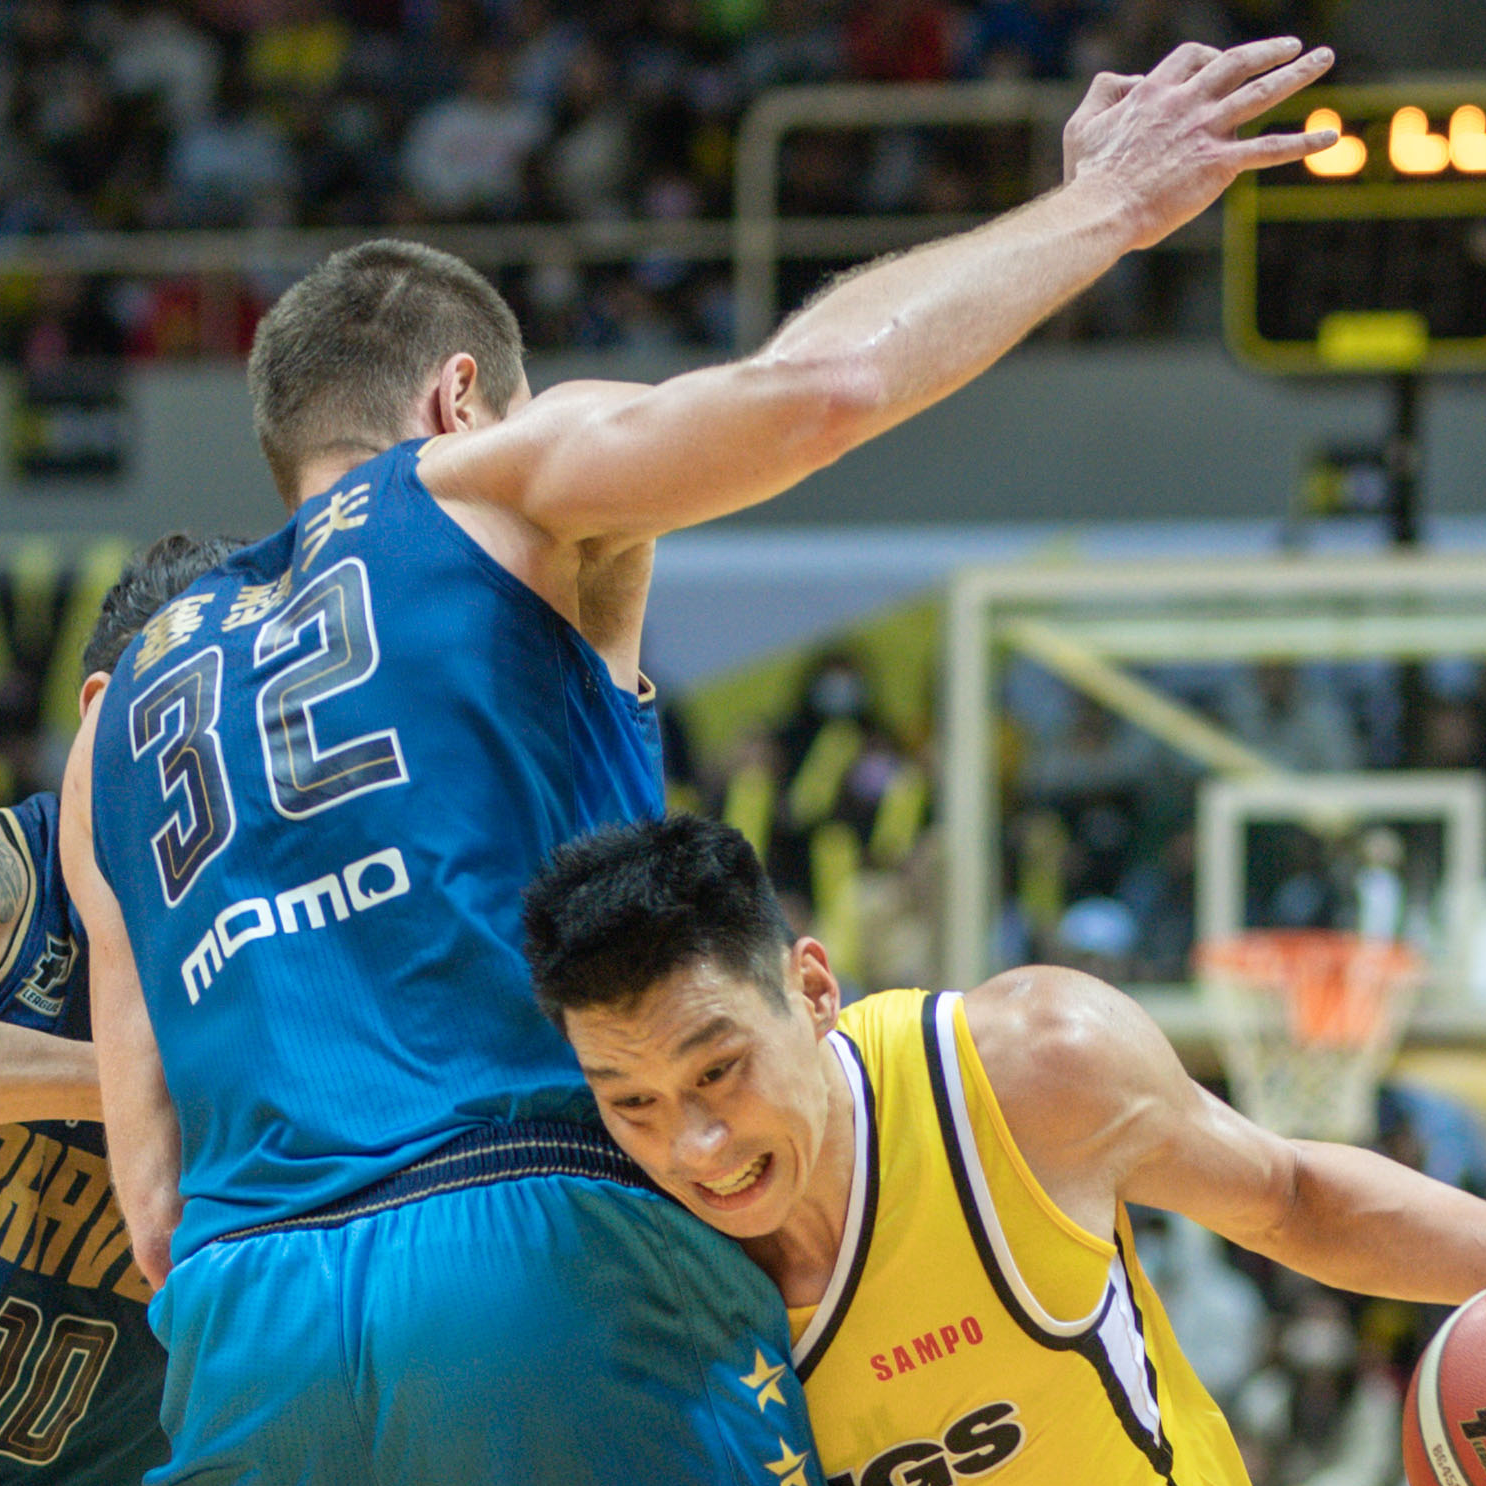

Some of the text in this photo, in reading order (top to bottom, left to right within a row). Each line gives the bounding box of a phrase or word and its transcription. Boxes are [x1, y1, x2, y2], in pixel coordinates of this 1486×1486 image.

[130, 556, 410, 909] 32
[181, 847, 411, 1006] momo
[22, 987, 61, 1014] LEAGUE
[870, 1315, 984, 1382] SAMPO
